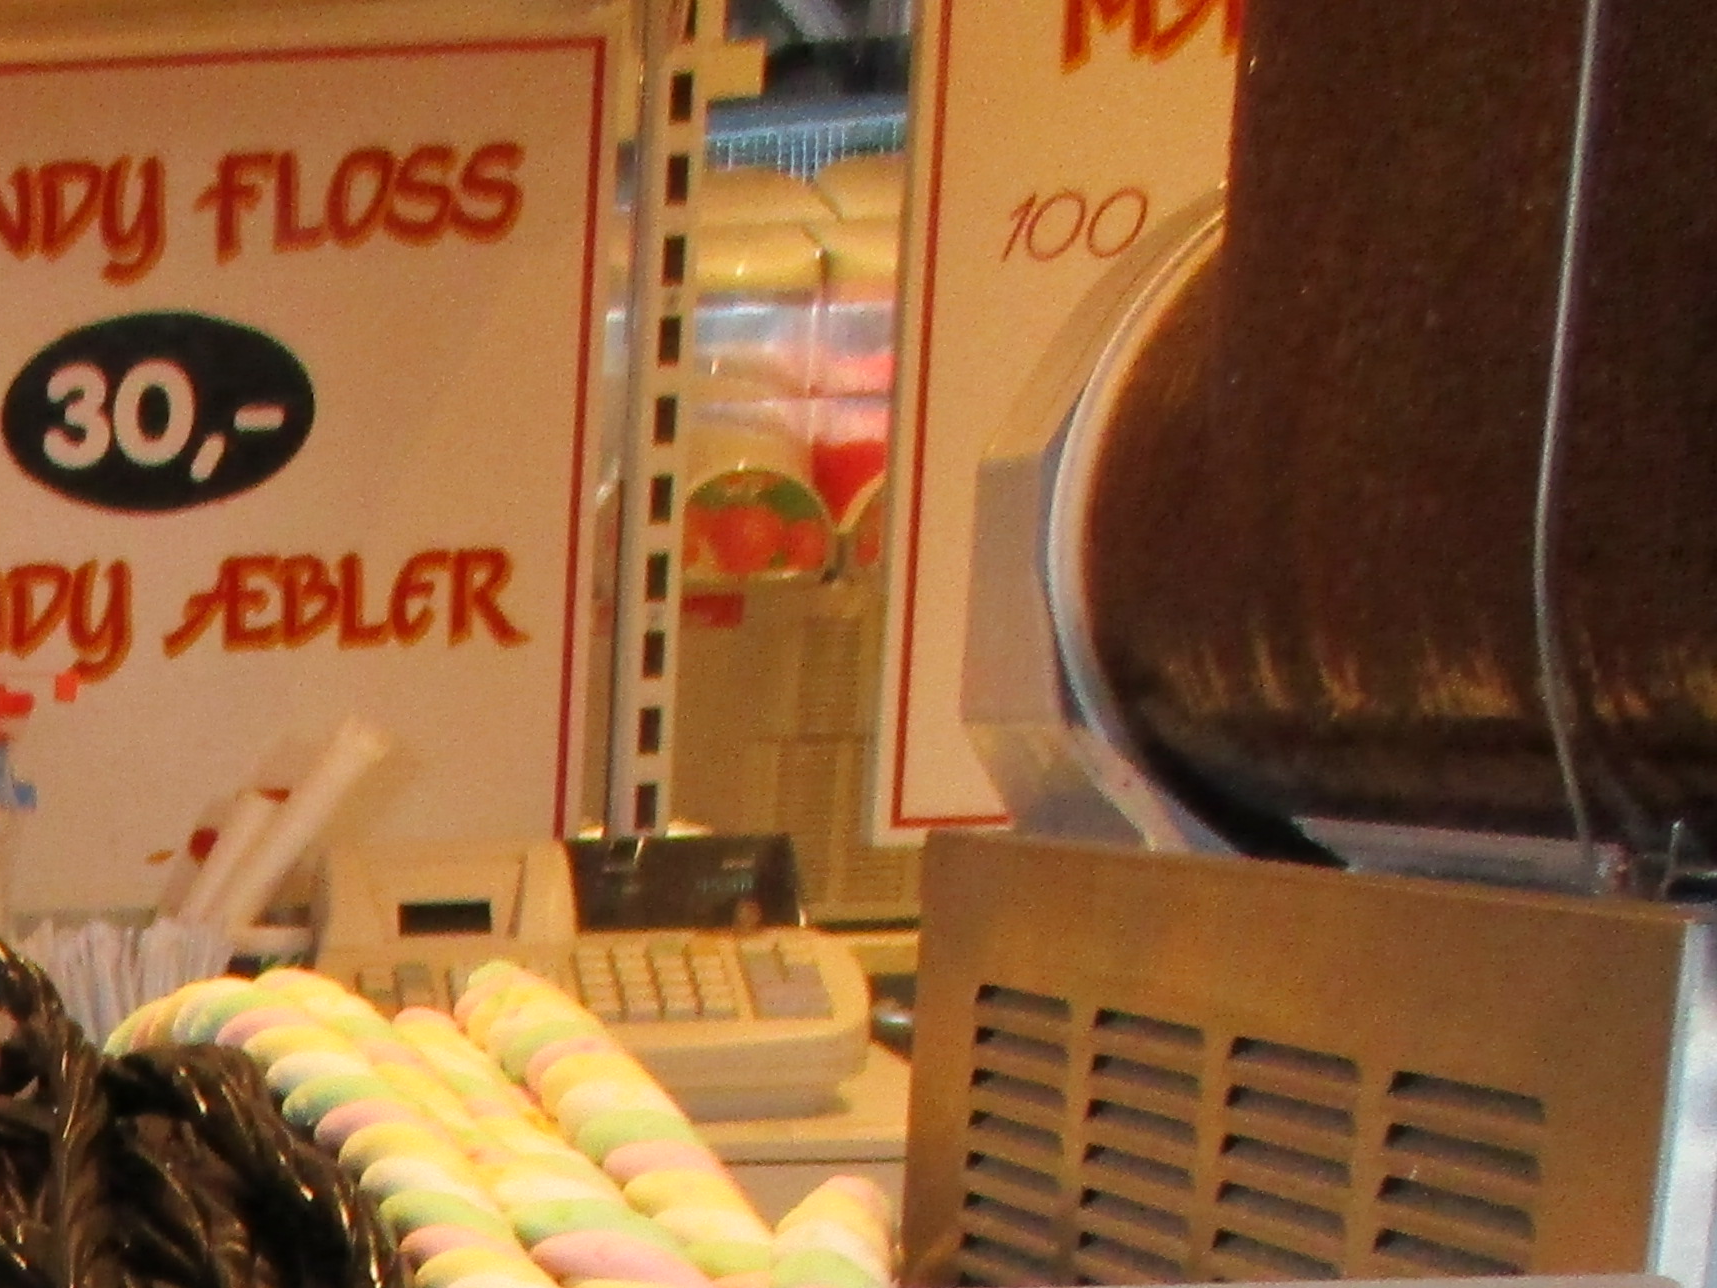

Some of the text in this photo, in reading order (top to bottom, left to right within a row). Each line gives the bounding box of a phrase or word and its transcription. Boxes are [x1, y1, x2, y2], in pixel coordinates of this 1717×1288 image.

[194, 141, 527, 266] FLOSS
[1000, 186, 1150, 264] 100
[41, 356, 287, 484] 30,-
[163, 546, 531, 658] ÆBLER
